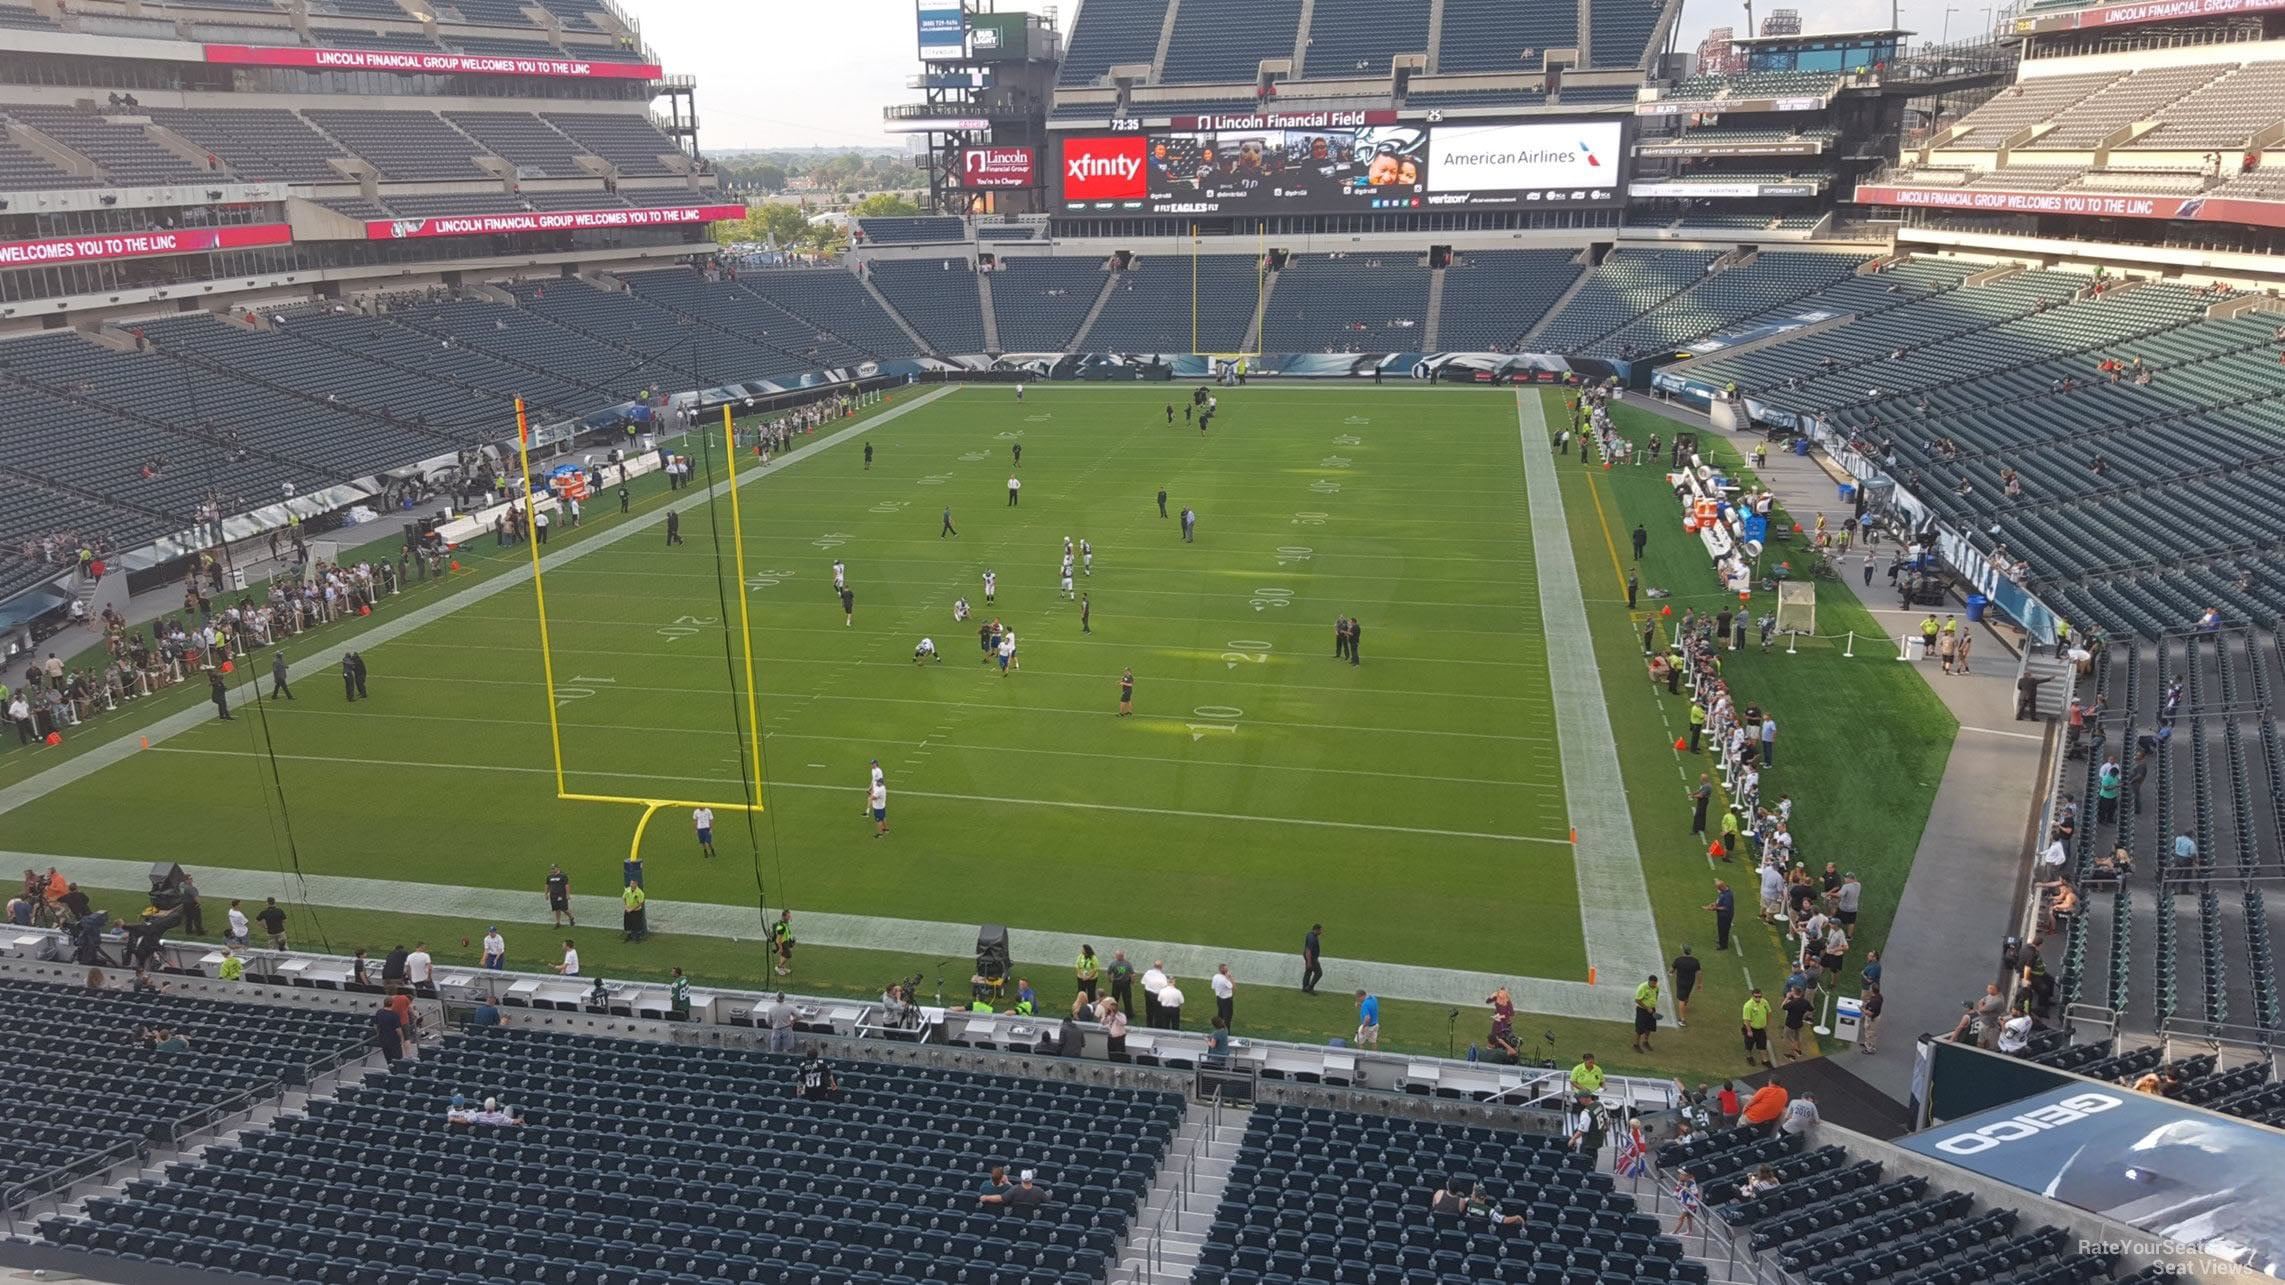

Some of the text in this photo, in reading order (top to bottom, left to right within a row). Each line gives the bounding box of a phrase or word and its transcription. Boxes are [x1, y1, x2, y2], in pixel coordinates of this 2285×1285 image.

[2105, 8, 2146, 22] LINCOLN
[2148, 2, 2200, 18] FINANCIAL
[316, 52, 590, 74] LINCOLN FINANCIAL GROUP WELCOMES YOU TO THE LINC
[1112, 119, 1140, 130] 73:35
[1215, 111, 1365, 129] Lincoln Financial Field
[986, 149, 1028, 163] Lincoln
[1444, 150, 1576, 166] American Airlines
[1068, 153, 1142, 182] xfinity
[1428, 194, 1469, 204] verizon
[1896, 191, 2154, 214] LINCOLN FINANCIAL GROUP WELCOMES YOU TO THE LINC
[436, 210, 700, 232] LINCOLN FINANCIAL GROUP WELCOMES YOU TO THE LINC
[0, 236, 176, 262] WELCOMES YOU TO THE LINC
[1934, 1093, 2124, 1155] GEICO
